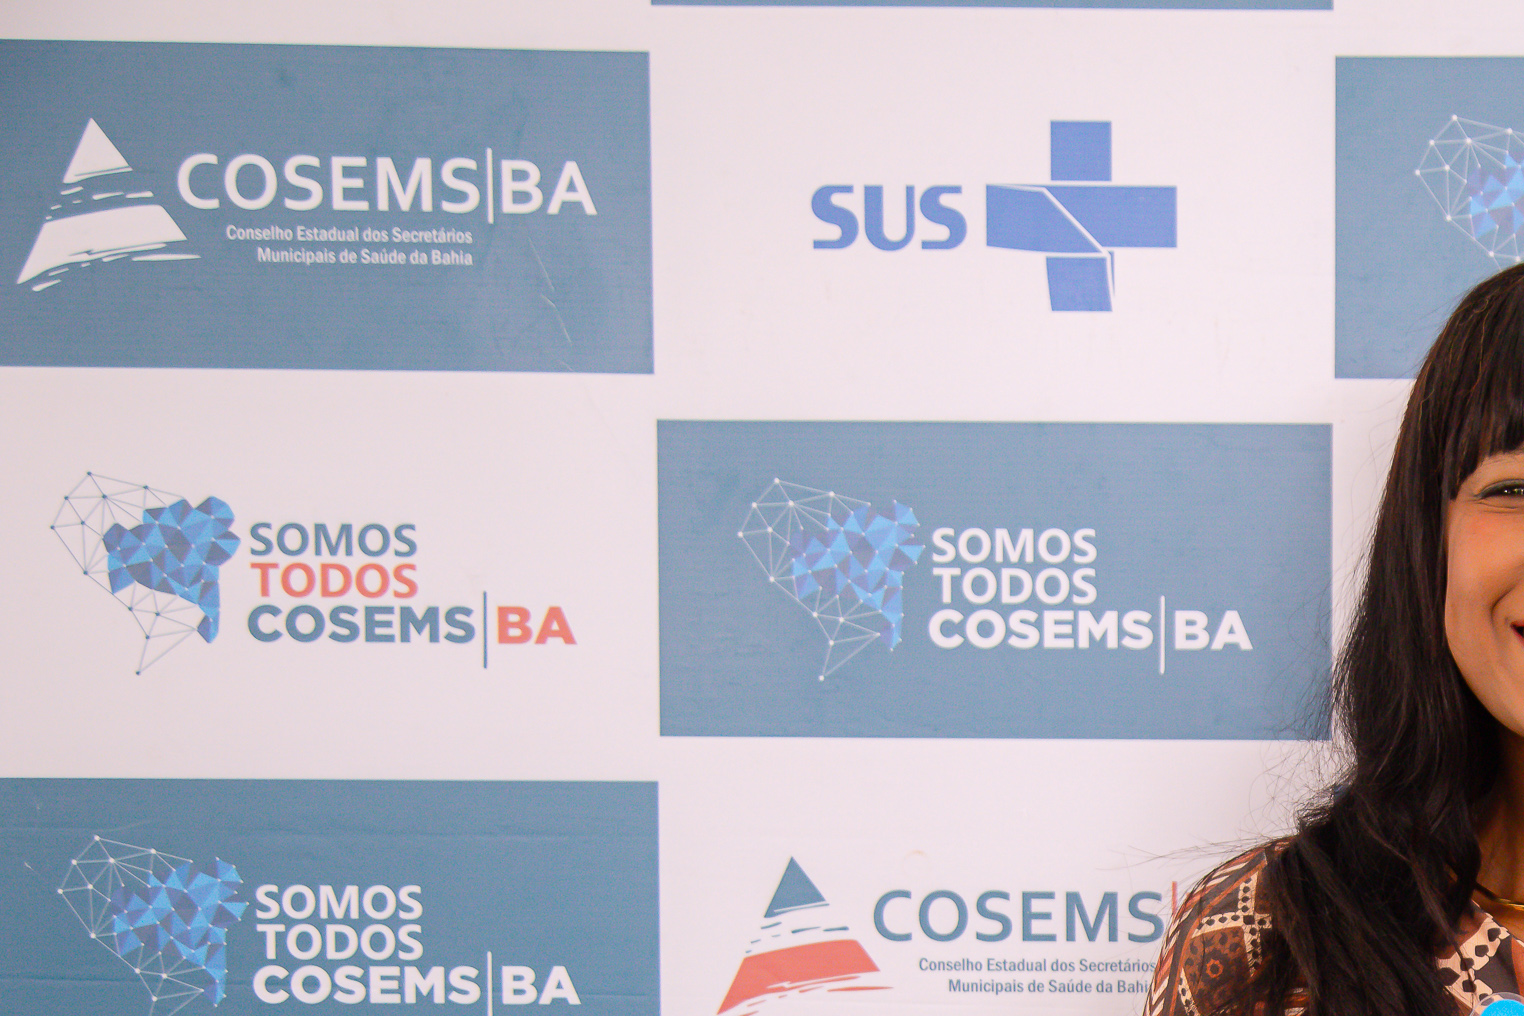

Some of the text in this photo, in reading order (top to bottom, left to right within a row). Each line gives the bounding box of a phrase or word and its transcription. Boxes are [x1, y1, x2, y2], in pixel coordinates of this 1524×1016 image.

[226, 225, 472, 244] Conselho Estadual dos Secretários
[811, 185, 966, 251] SUS
[258, 247, 473, 265] Municipais de Saúde da Bahia
[250, 522, 416, 557] SOMOS
[932, 528, 1096, 564] SOMOS
[250, 562, 417, 598] TODOS
[933, 568, 1096, 604] TODOS
[256, 884, 422, 920] SOMOS
[256, 924, 423, 960] TODOS
[919, 958, 1155, 972] Conselho Estadual dos Secretários
[949, 979, 1148, 995] Municipais de Saúde da Bahi
